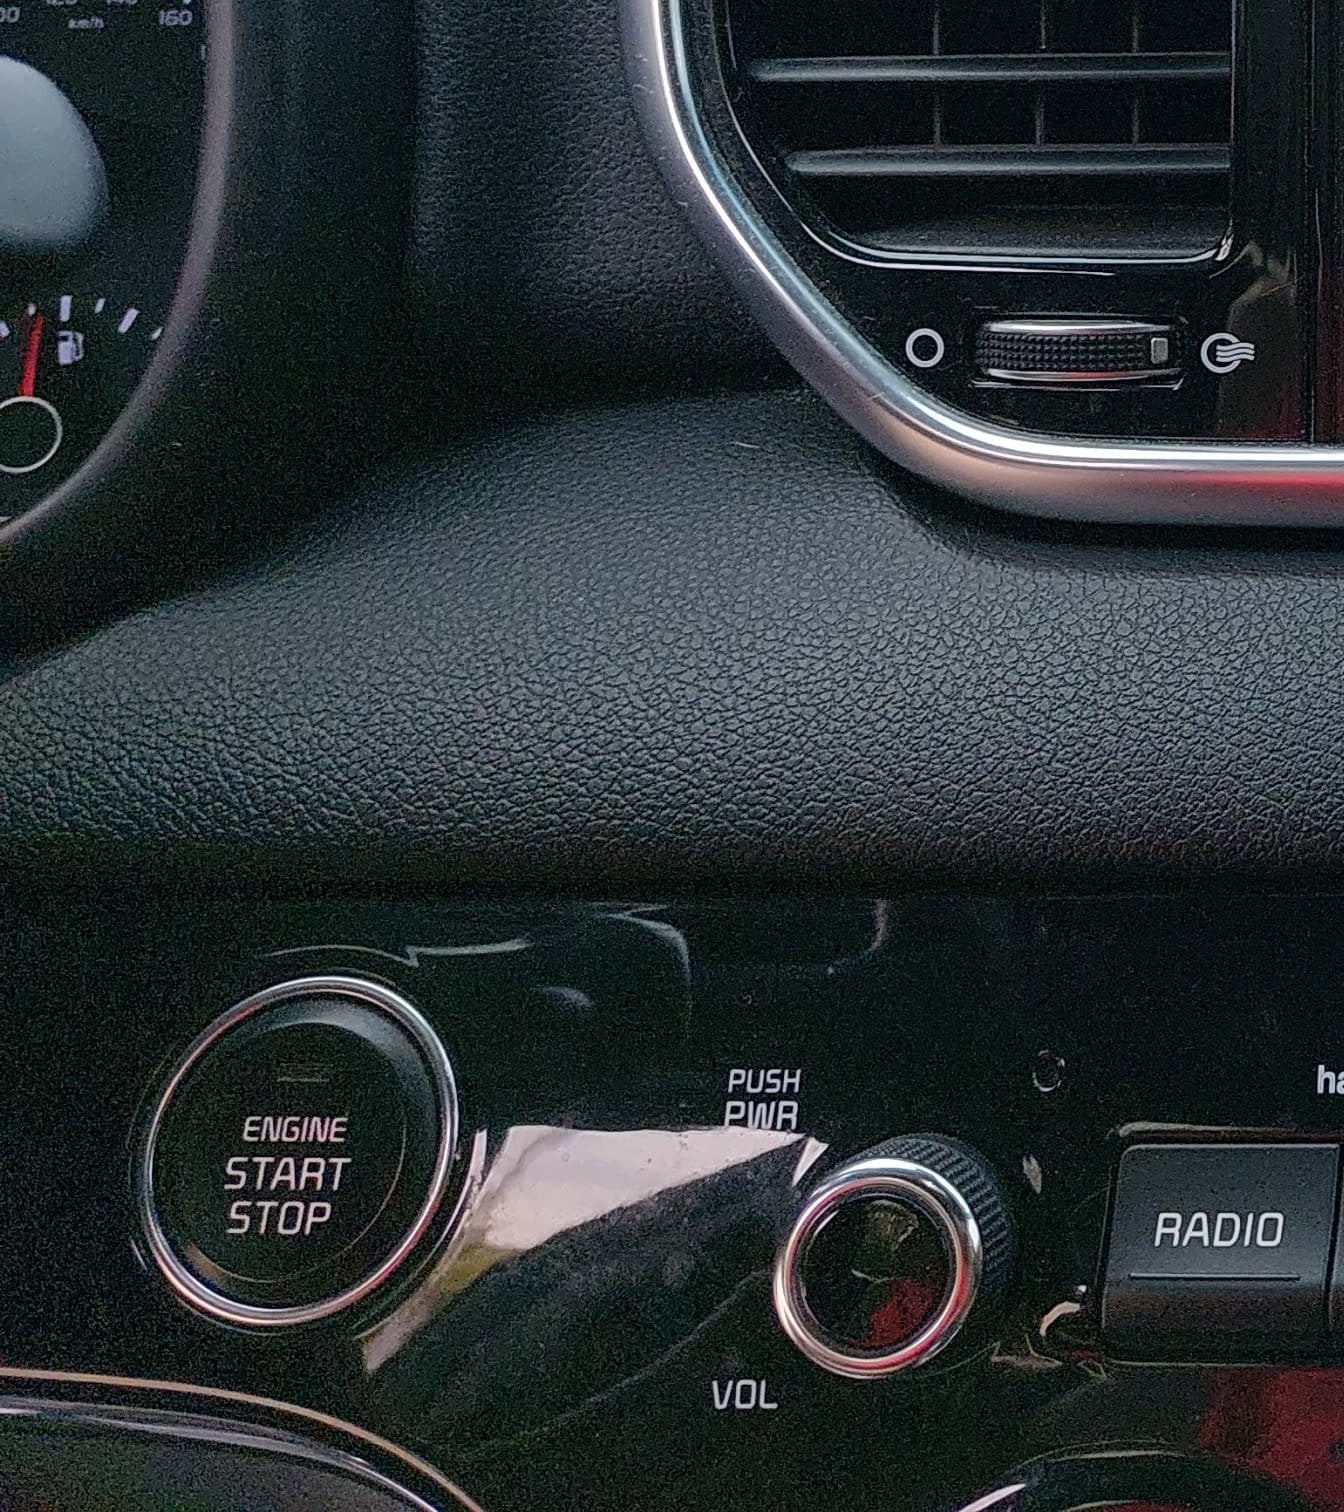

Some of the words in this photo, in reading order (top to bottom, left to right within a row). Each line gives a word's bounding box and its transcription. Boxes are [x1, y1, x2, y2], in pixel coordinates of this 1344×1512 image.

[158, 8, 193, 26] 160
[727, 1068, 802, 1094] PUSH
[242, 1116, 348, 1143] ENGINE
[724, 1101, 798, 1129] PWR
[223, 1156, 352, 1191] START
[226, 1200, 332, 1235] STOP
[1154, 1212, 1284, 1247] RADIO
[711, 1379, 778, 1410] VOL
